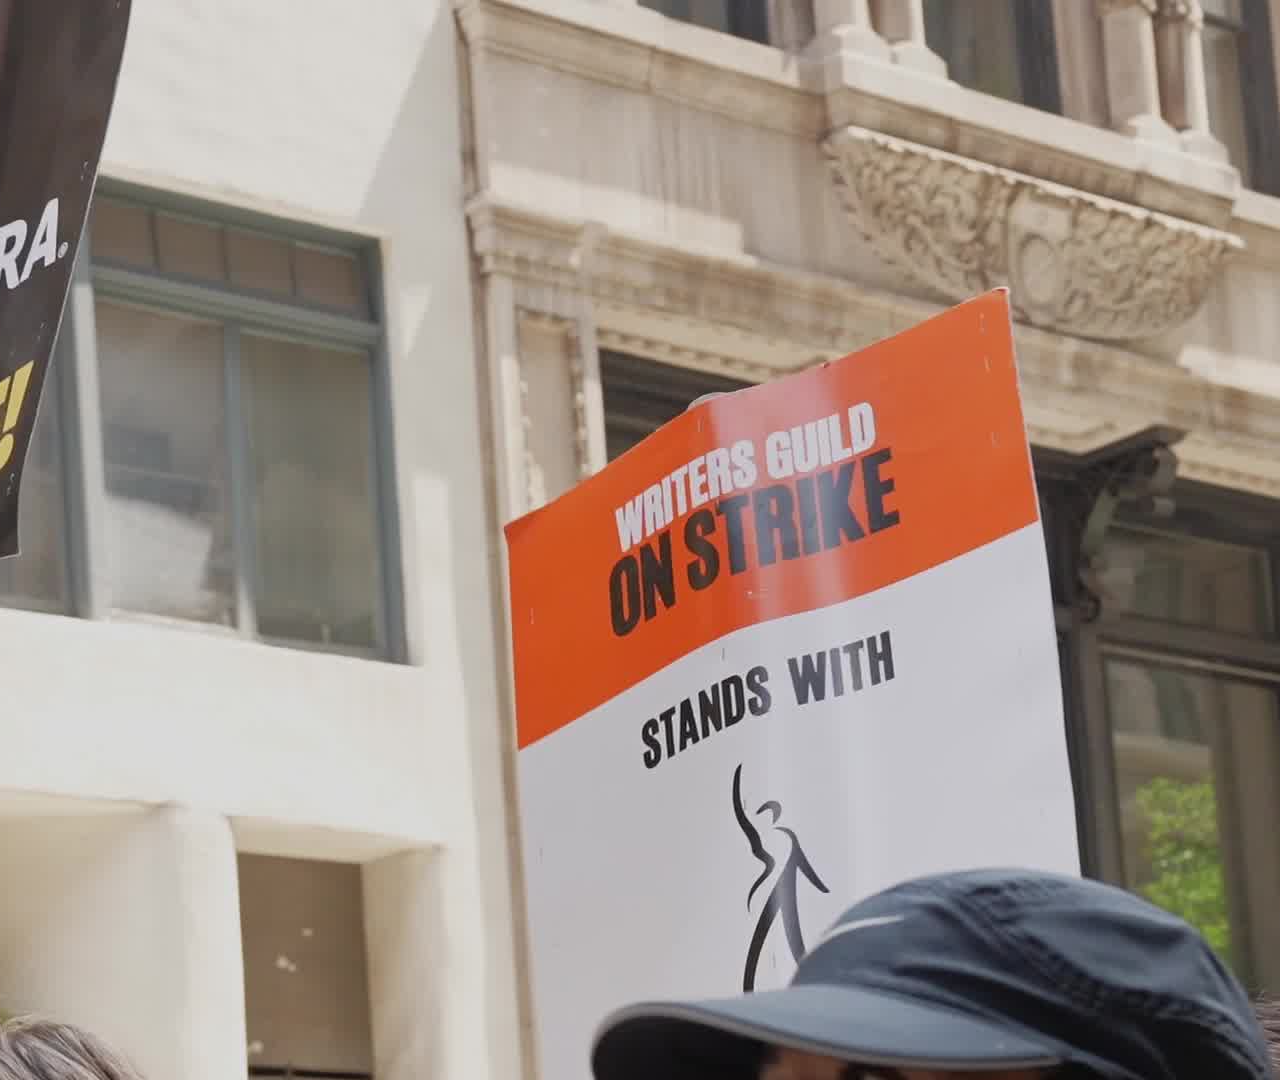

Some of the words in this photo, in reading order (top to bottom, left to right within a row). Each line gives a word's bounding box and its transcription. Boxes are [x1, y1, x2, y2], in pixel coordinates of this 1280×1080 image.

[608, 526, 676, 638] ON
[684, 448, 900, 593] STRIKE
[615, 440, 758, 553] WRITERS
[765, 402, 877, 480] GUILD
[640, 665, 772, 770] STANDS
[787, 630, 896, 706] WITH
